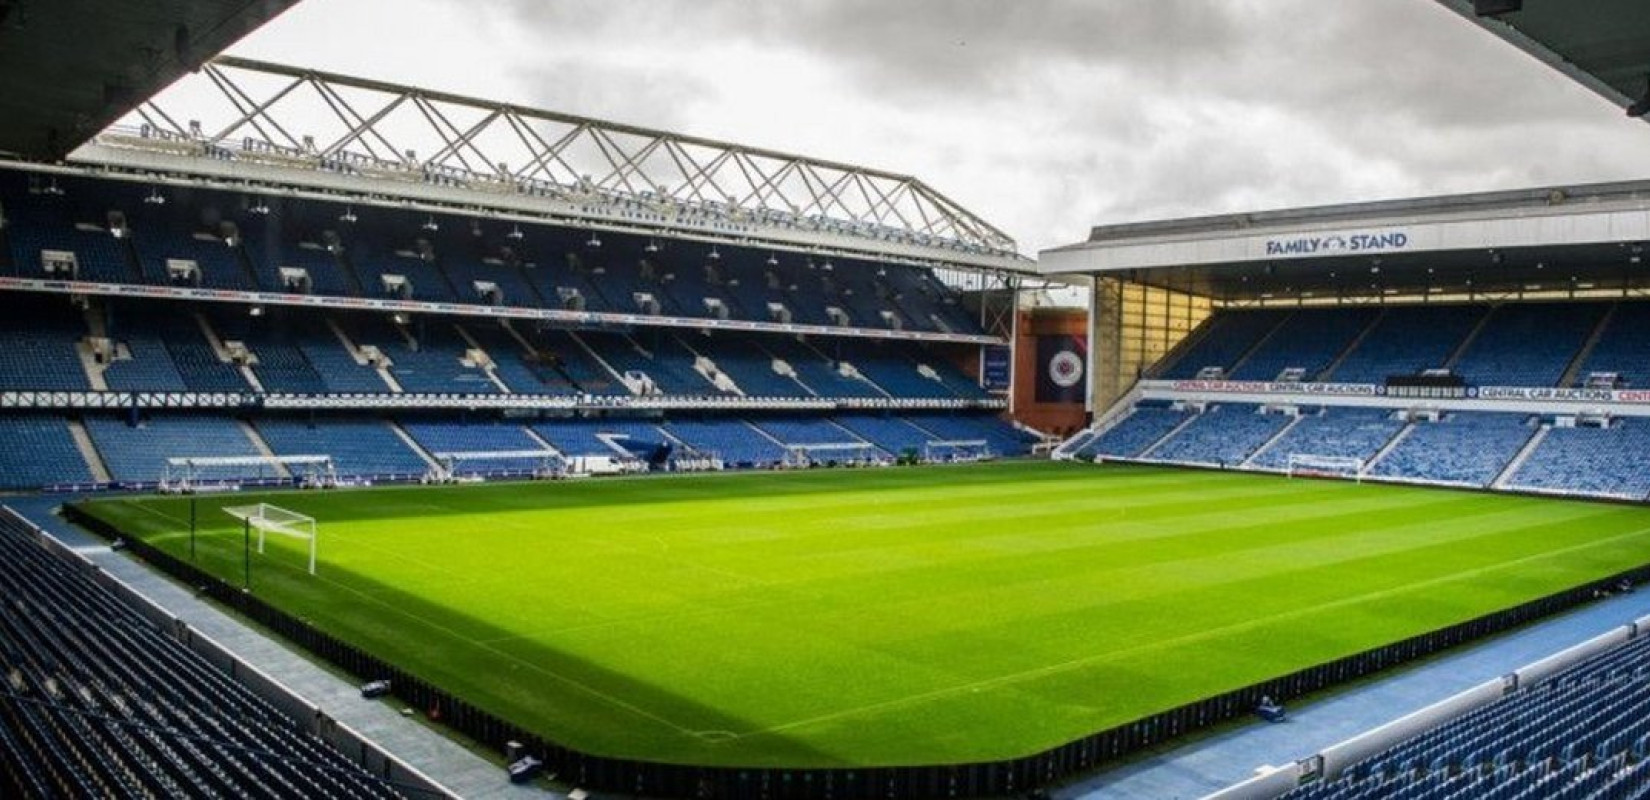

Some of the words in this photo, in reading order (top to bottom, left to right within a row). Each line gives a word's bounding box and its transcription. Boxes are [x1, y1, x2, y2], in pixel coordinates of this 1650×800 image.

[1266, 237, 1320, 254] FAMILY
[1350, 233, 1407, 250] STAND
[1270, 383, 1307, 392] CENTRAL
[1308, 383, 1325, 393] CAR
[1327, 384, 1373, 394] AUCTIONS
[1481, 387, 1526, 398] CENTRAL
[1530, 388, 1552, 399] CAR
[1554, 389, 1613, 401] AUCTIONS
